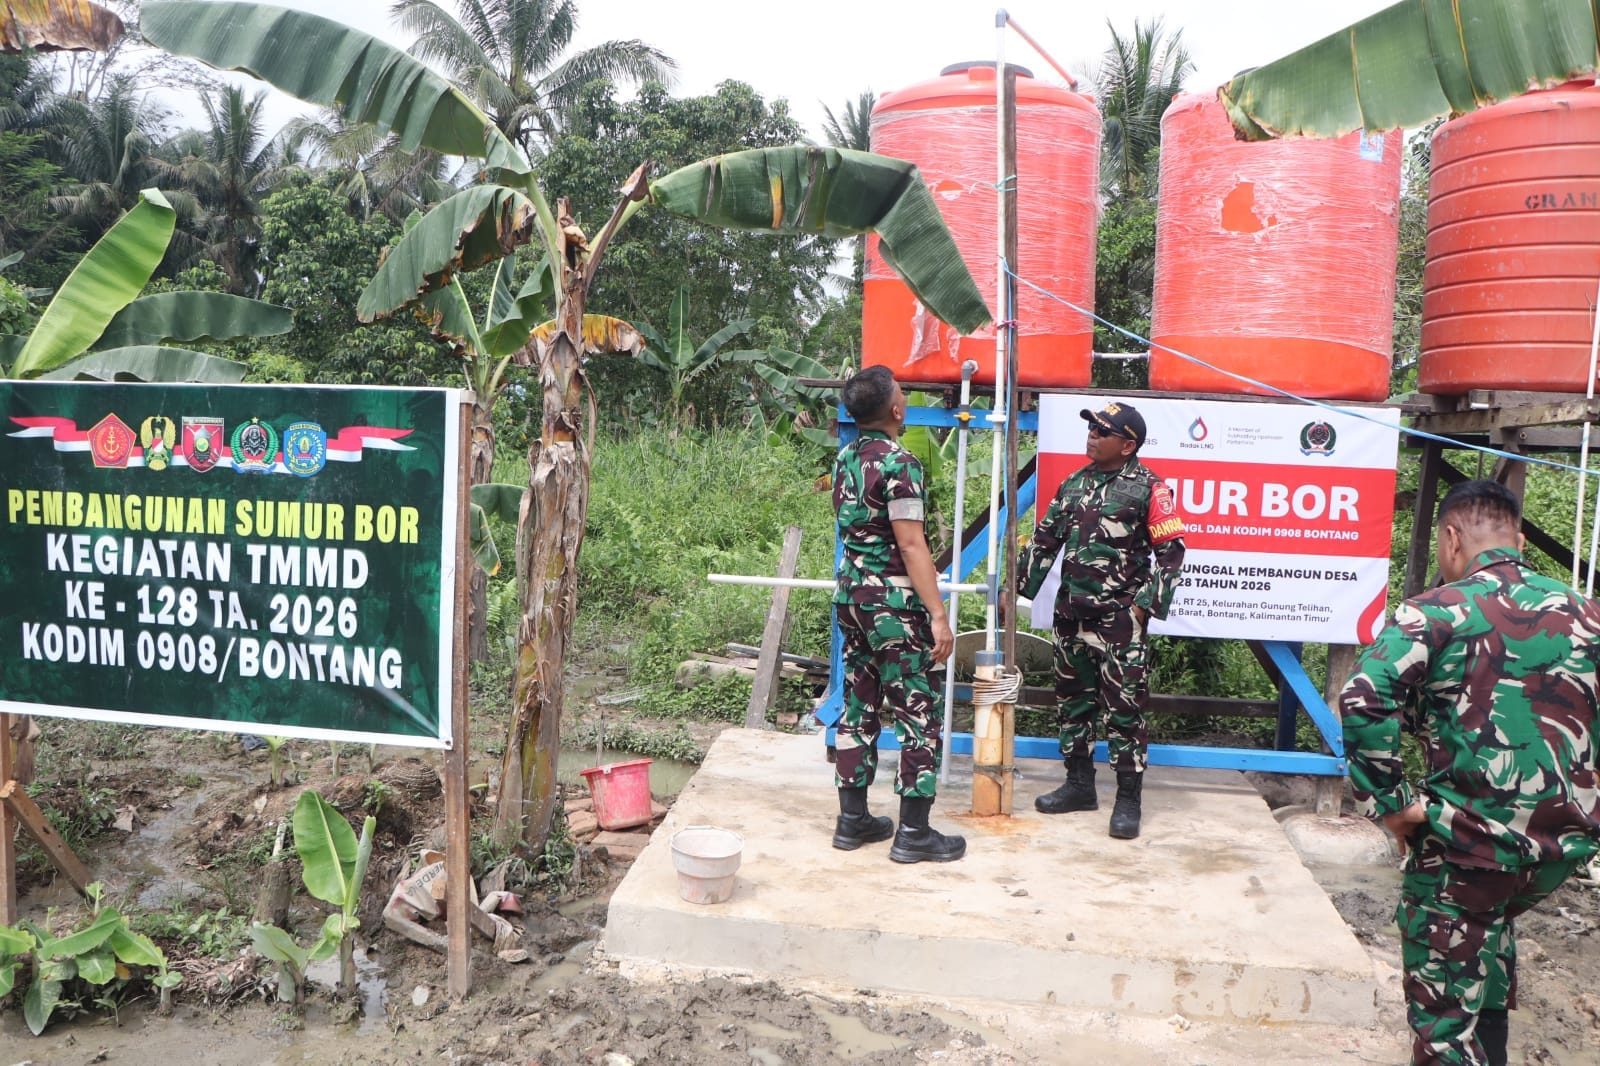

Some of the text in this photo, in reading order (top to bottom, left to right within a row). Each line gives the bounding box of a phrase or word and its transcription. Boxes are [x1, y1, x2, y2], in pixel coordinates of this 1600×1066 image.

[8, 489, 419, 544] PEMBANGUNAN SUMUR BOR
[1260, 482, 1360, 522] BOR
[1206, 524, 1231, 535] DAN
[1233, 526, 1272, 537] KODIM
[1274, 528, 1302, 538] 0908
[1303, 530, 1359, 541] BONTANG
[47, 533, 369, 589] KEGIATAN TMMD
[1182, 564, 1358, 582] UNGGAL MEMBANGUN DESA
[1194, 578, 1238, 590] TAHUN
[1241, 581, 1271, 591] 2026
[65, 580, 106, 620] KE
[137, 584, 198, 627] 128
[208, 590, 258, 631] TA.
[269, 593, 358, 638] 2026
[1178, 608, 1205, 618] Barat,
[1207, 609, 1247, 621] Bontang,
[1250, 611, 1302, 621] Kalimantan
[1304, 614, 1330, 623] Timur
[1183, 598, 1195, 606] RT
[1196, 599, 1210, 607] 25,
[1212, 599, 1258, 609] Kelurahan
[1260, 601, 1296, 612] Gunung
[1298, 603, 1333, 614] Telihan,
[22, 622, 403, 689] KODIM 0908/BONTANG
